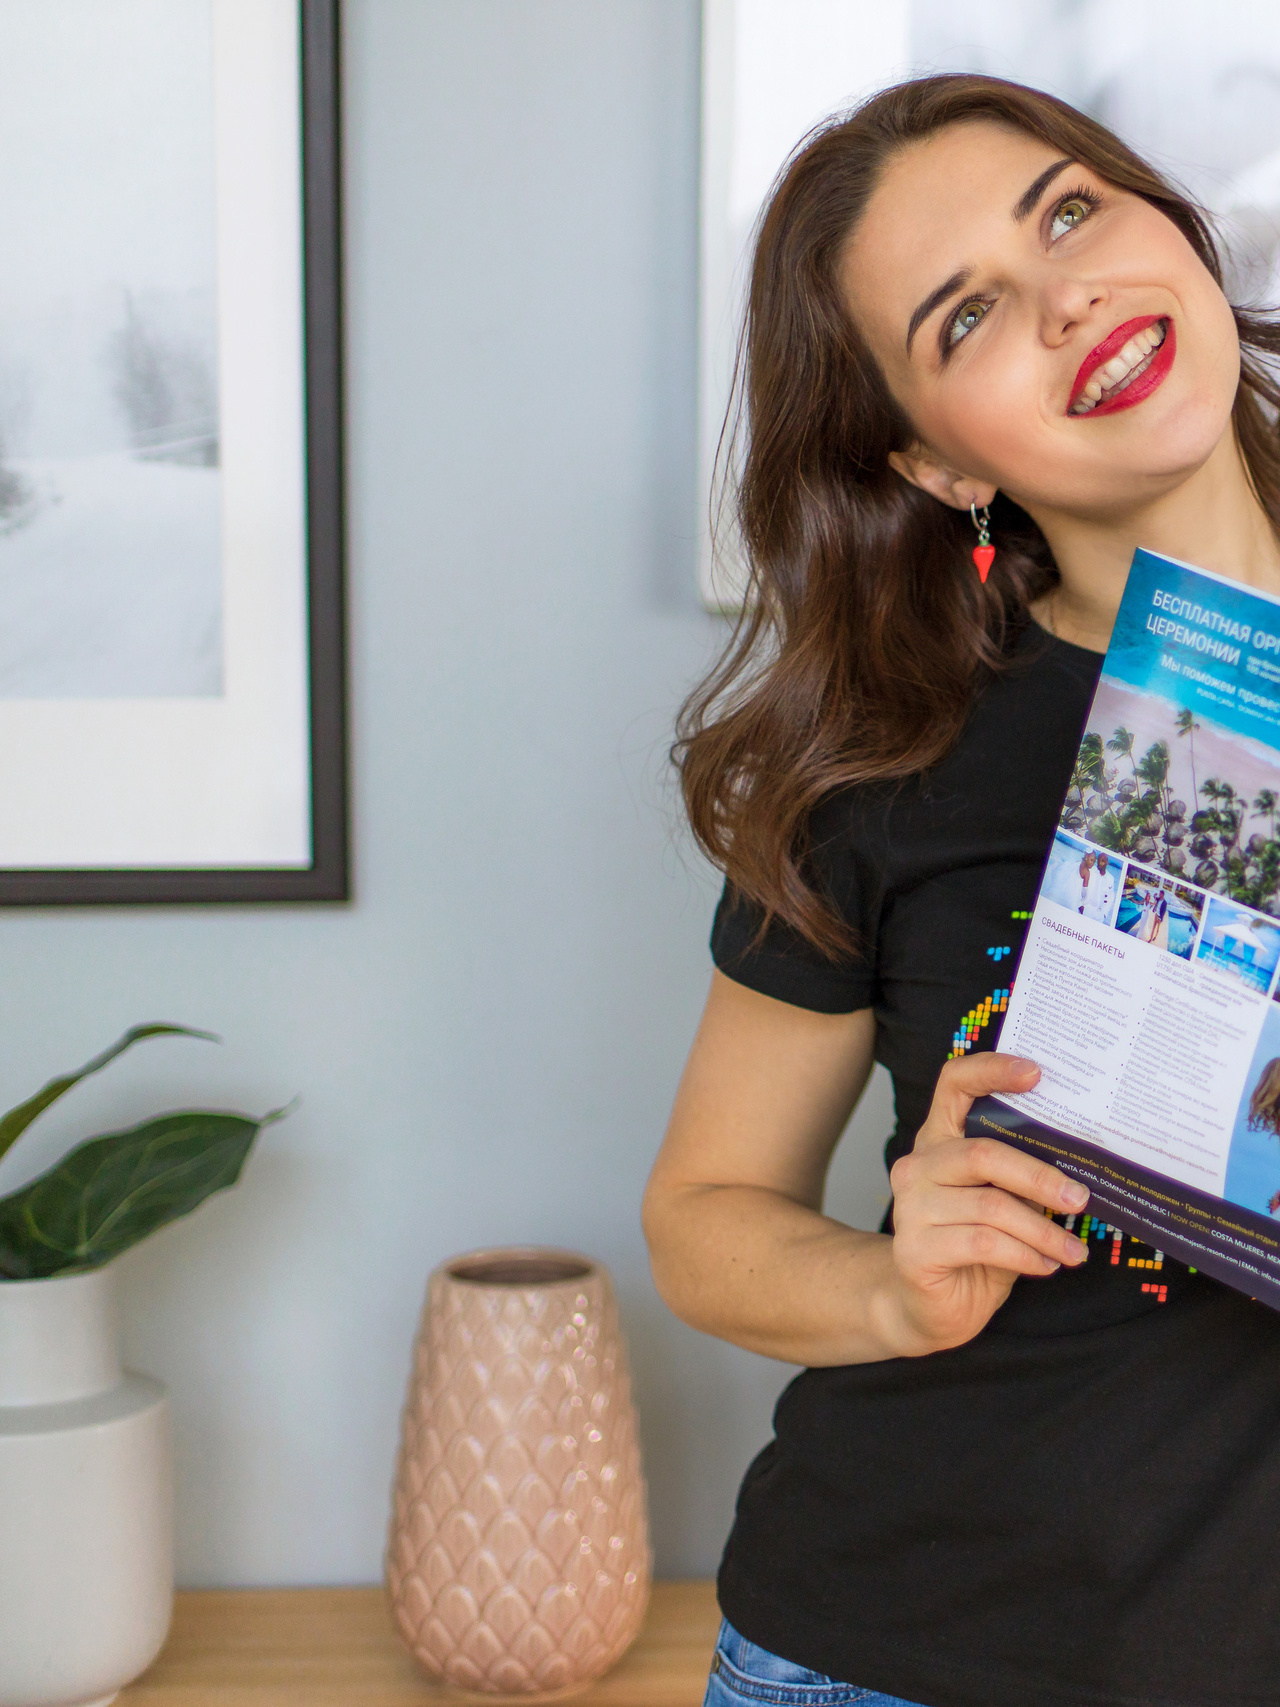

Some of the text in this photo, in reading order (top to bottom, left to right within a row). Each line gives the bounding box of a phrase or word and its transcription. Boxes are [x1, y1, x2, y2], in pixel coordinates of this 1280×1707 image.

[1143, 612, 1242, 665] ЦЕРЕМОНИИ
[1150, 589, 1253, 643] БЕСПЛАТНАЯ
[1159, 654, 1181, 673] Мы
[1181, 666, 1237, 695] поможем
[1040, 916, 1125, 959] СВАДЕБНЫЕ ПАКЕТЫ
[978, 1114, 1017, 1138] Проведение
[1023, 1135, 1068, 1156] организация
[1068, 1152, 1100, 1168] свадьбы
[1103, 1165, 1126, 1182] Отдых
[1125, 1178, 1139, 1188] для
[1139, 1184, 1180, 1206] молодожен
[1055, 1158, 1079, 1173] PUNTA
[1078, 1168, 1099, 1184] CANA,
[1098, 1178, 1137, 1200] DOMINICAN
[1136, 1196, 1167, 1215] REPUBLIC
[1169, 1212, 1189, 1224] NOW
[1210, 1229, 1234, 1243] COSTA
[1233, 1238, 1267, 1259] MUJERES,
